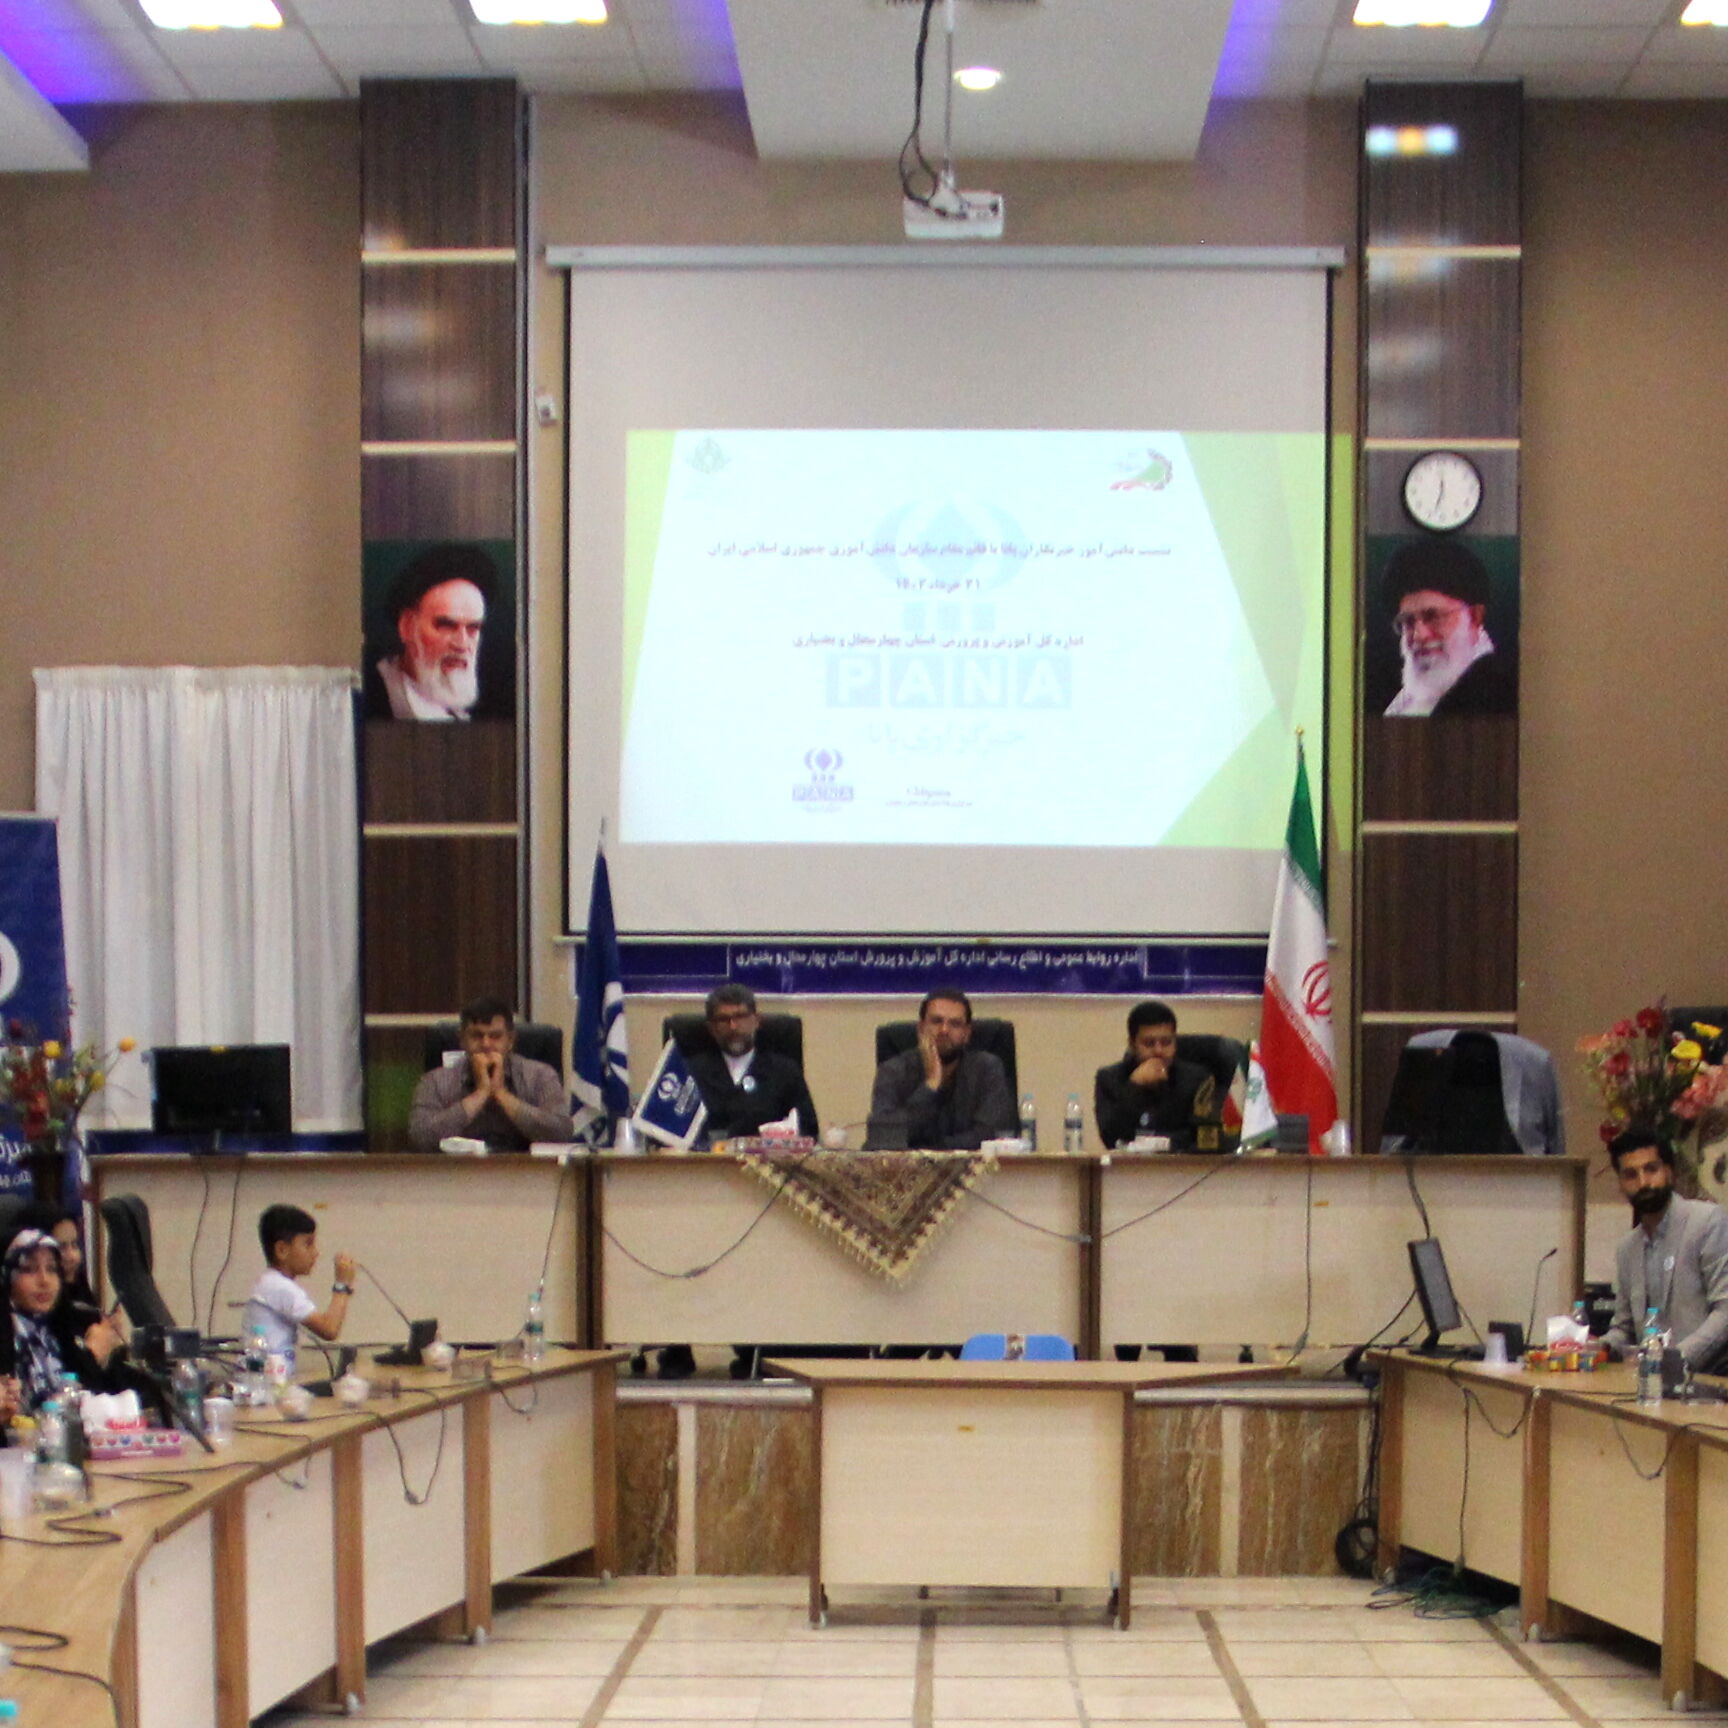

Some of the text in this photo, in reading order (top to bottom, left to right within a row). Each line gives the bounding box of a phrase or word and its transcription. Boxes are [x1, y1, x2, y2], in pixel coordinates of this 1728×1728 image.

[706, 541, 736, 557] ایران
[738, 541, 778, 558] اسلامی
[792, 632, 836, 650] بختیاری
[904, 632, 936, 649] استان
[939, 636, 981, 651] پرورش
[991, 633, 1031, 650] آموزش
[1054, 633, 1084, 650] اداره
[834, 656, 1068, 706] PANA
[735, 949, 773, 970] بختیاری
[828, 949, 858, 968] استان
[859, 948, 896, 969] پرورش
[905, 946, 941, 968] آموزش
[960, 949, 985, 967] اداره
[986, 949, 1016, 967] رسانی
[1017, 949, 1043, 971] اطلاع
[1052, 952, 1084, 968] عمومی
[1085, 949, 1113, 967] روابط
[1113, 949, 1140, 967] اداره
